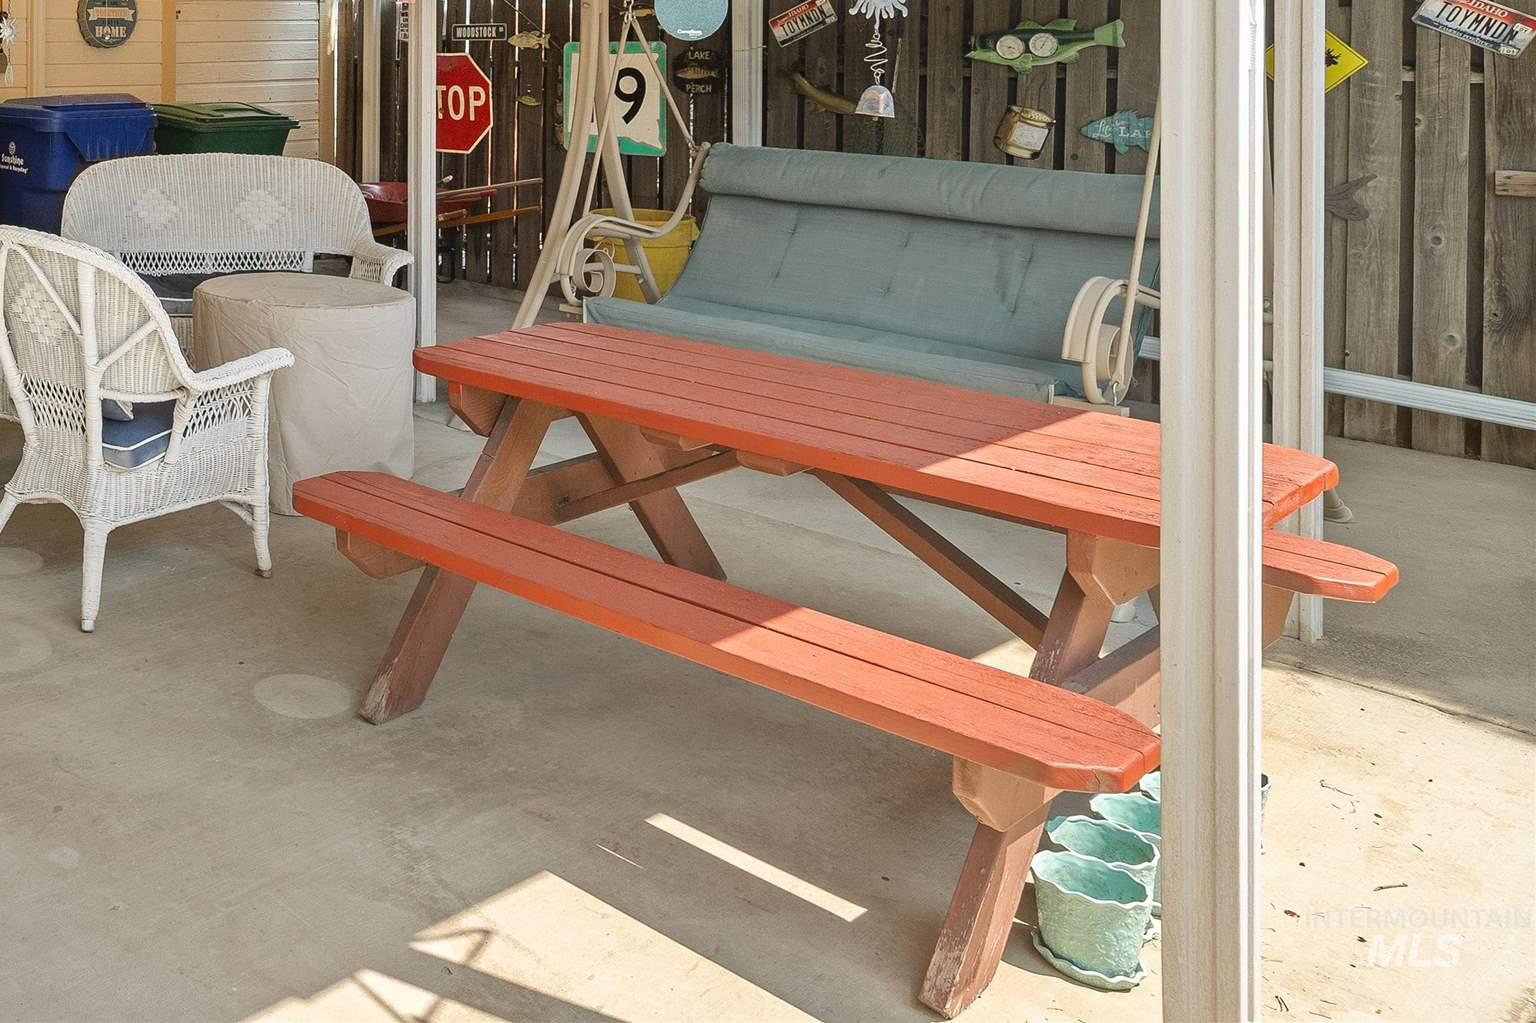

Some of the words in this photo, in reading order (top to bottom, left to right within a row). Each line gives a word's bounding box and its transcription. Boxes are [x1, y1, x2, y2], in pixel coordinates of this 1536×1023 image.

[1469, 0, 1508, 17] IDAHO
[95, 26, 127, 38] HOME
[456, 26, 497, 38] WOODSTOCK
[688, 51, 712, 60] LAKE
[686, 84, 712, 93] PERCH
[436, 85, 486, 121] TOP
